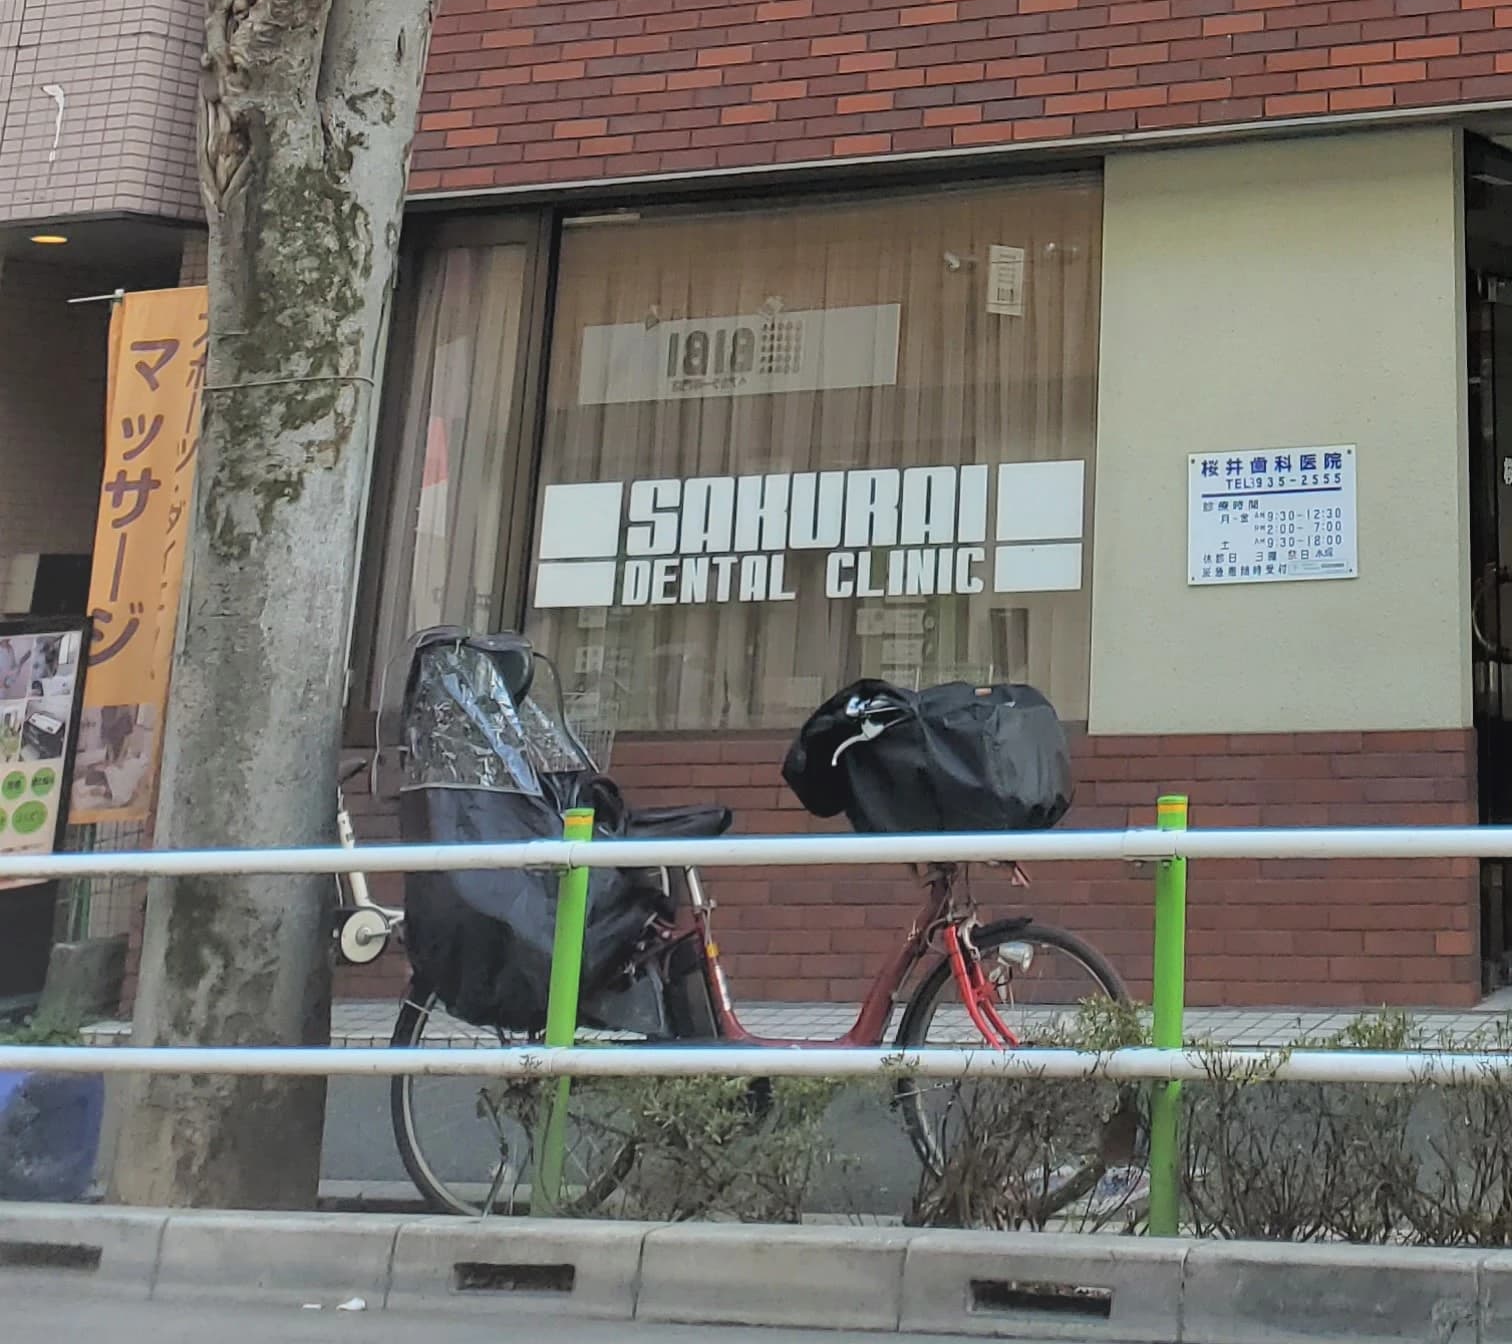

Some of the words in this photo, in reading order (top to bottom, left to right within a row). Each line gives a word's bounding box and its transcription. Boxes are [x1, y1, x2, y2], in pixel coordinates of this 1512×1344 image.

[87, 338, 181, 666] マッサージ
[1201, 452, 1343, 478] 桜井歯科医院
[625, 464, 989, 557] SAKURAI
[622, 554, 796, 607] DENTAL
[826, 546, 985, 599] CLINIC
